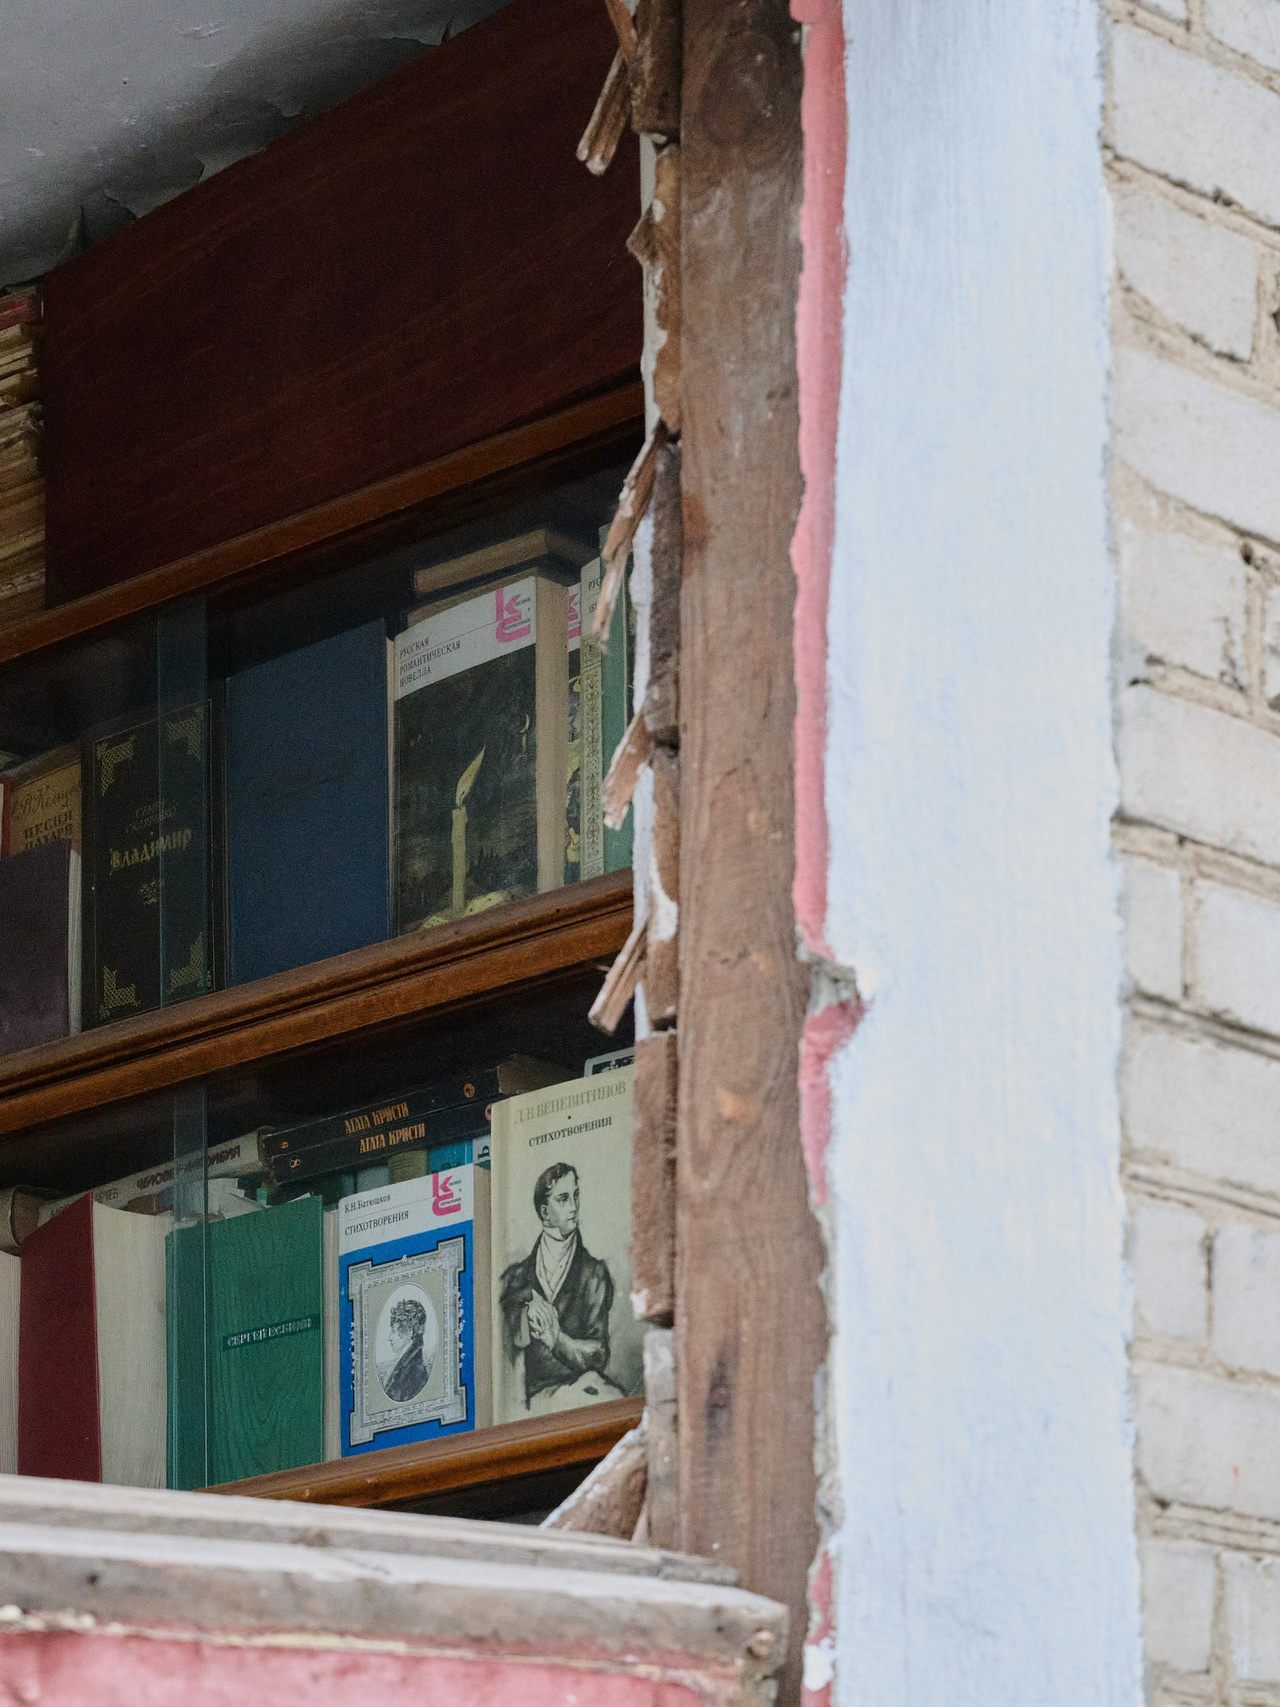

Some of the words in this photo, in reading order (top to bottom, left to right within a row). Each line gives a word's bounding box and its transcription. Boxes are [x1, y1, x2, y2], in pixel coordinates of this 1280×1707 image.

[399, 637, 430, 661] РУССКАЯ
[399, 640, 461, 676] РОМАНТИЧЕСКАЯ
[400, 666, 432, 687] НОВЕЛЛА
[344, 1114, 372, 1135] АГАТА
[372, 1101, 410, 1127] КРИСТИ
[528, 1116, 613, 1148] СТИХОТВОРЕНИЯ
[359, 1133, 387, 1154] АГАТА
[388, 1122, 427, 1146] КРИСТИ
[344, 1210, 409, 1236] СТИХОТВОРЕНИЯ
[226, 1326, 267, 1347] СЕРГЕЙ
